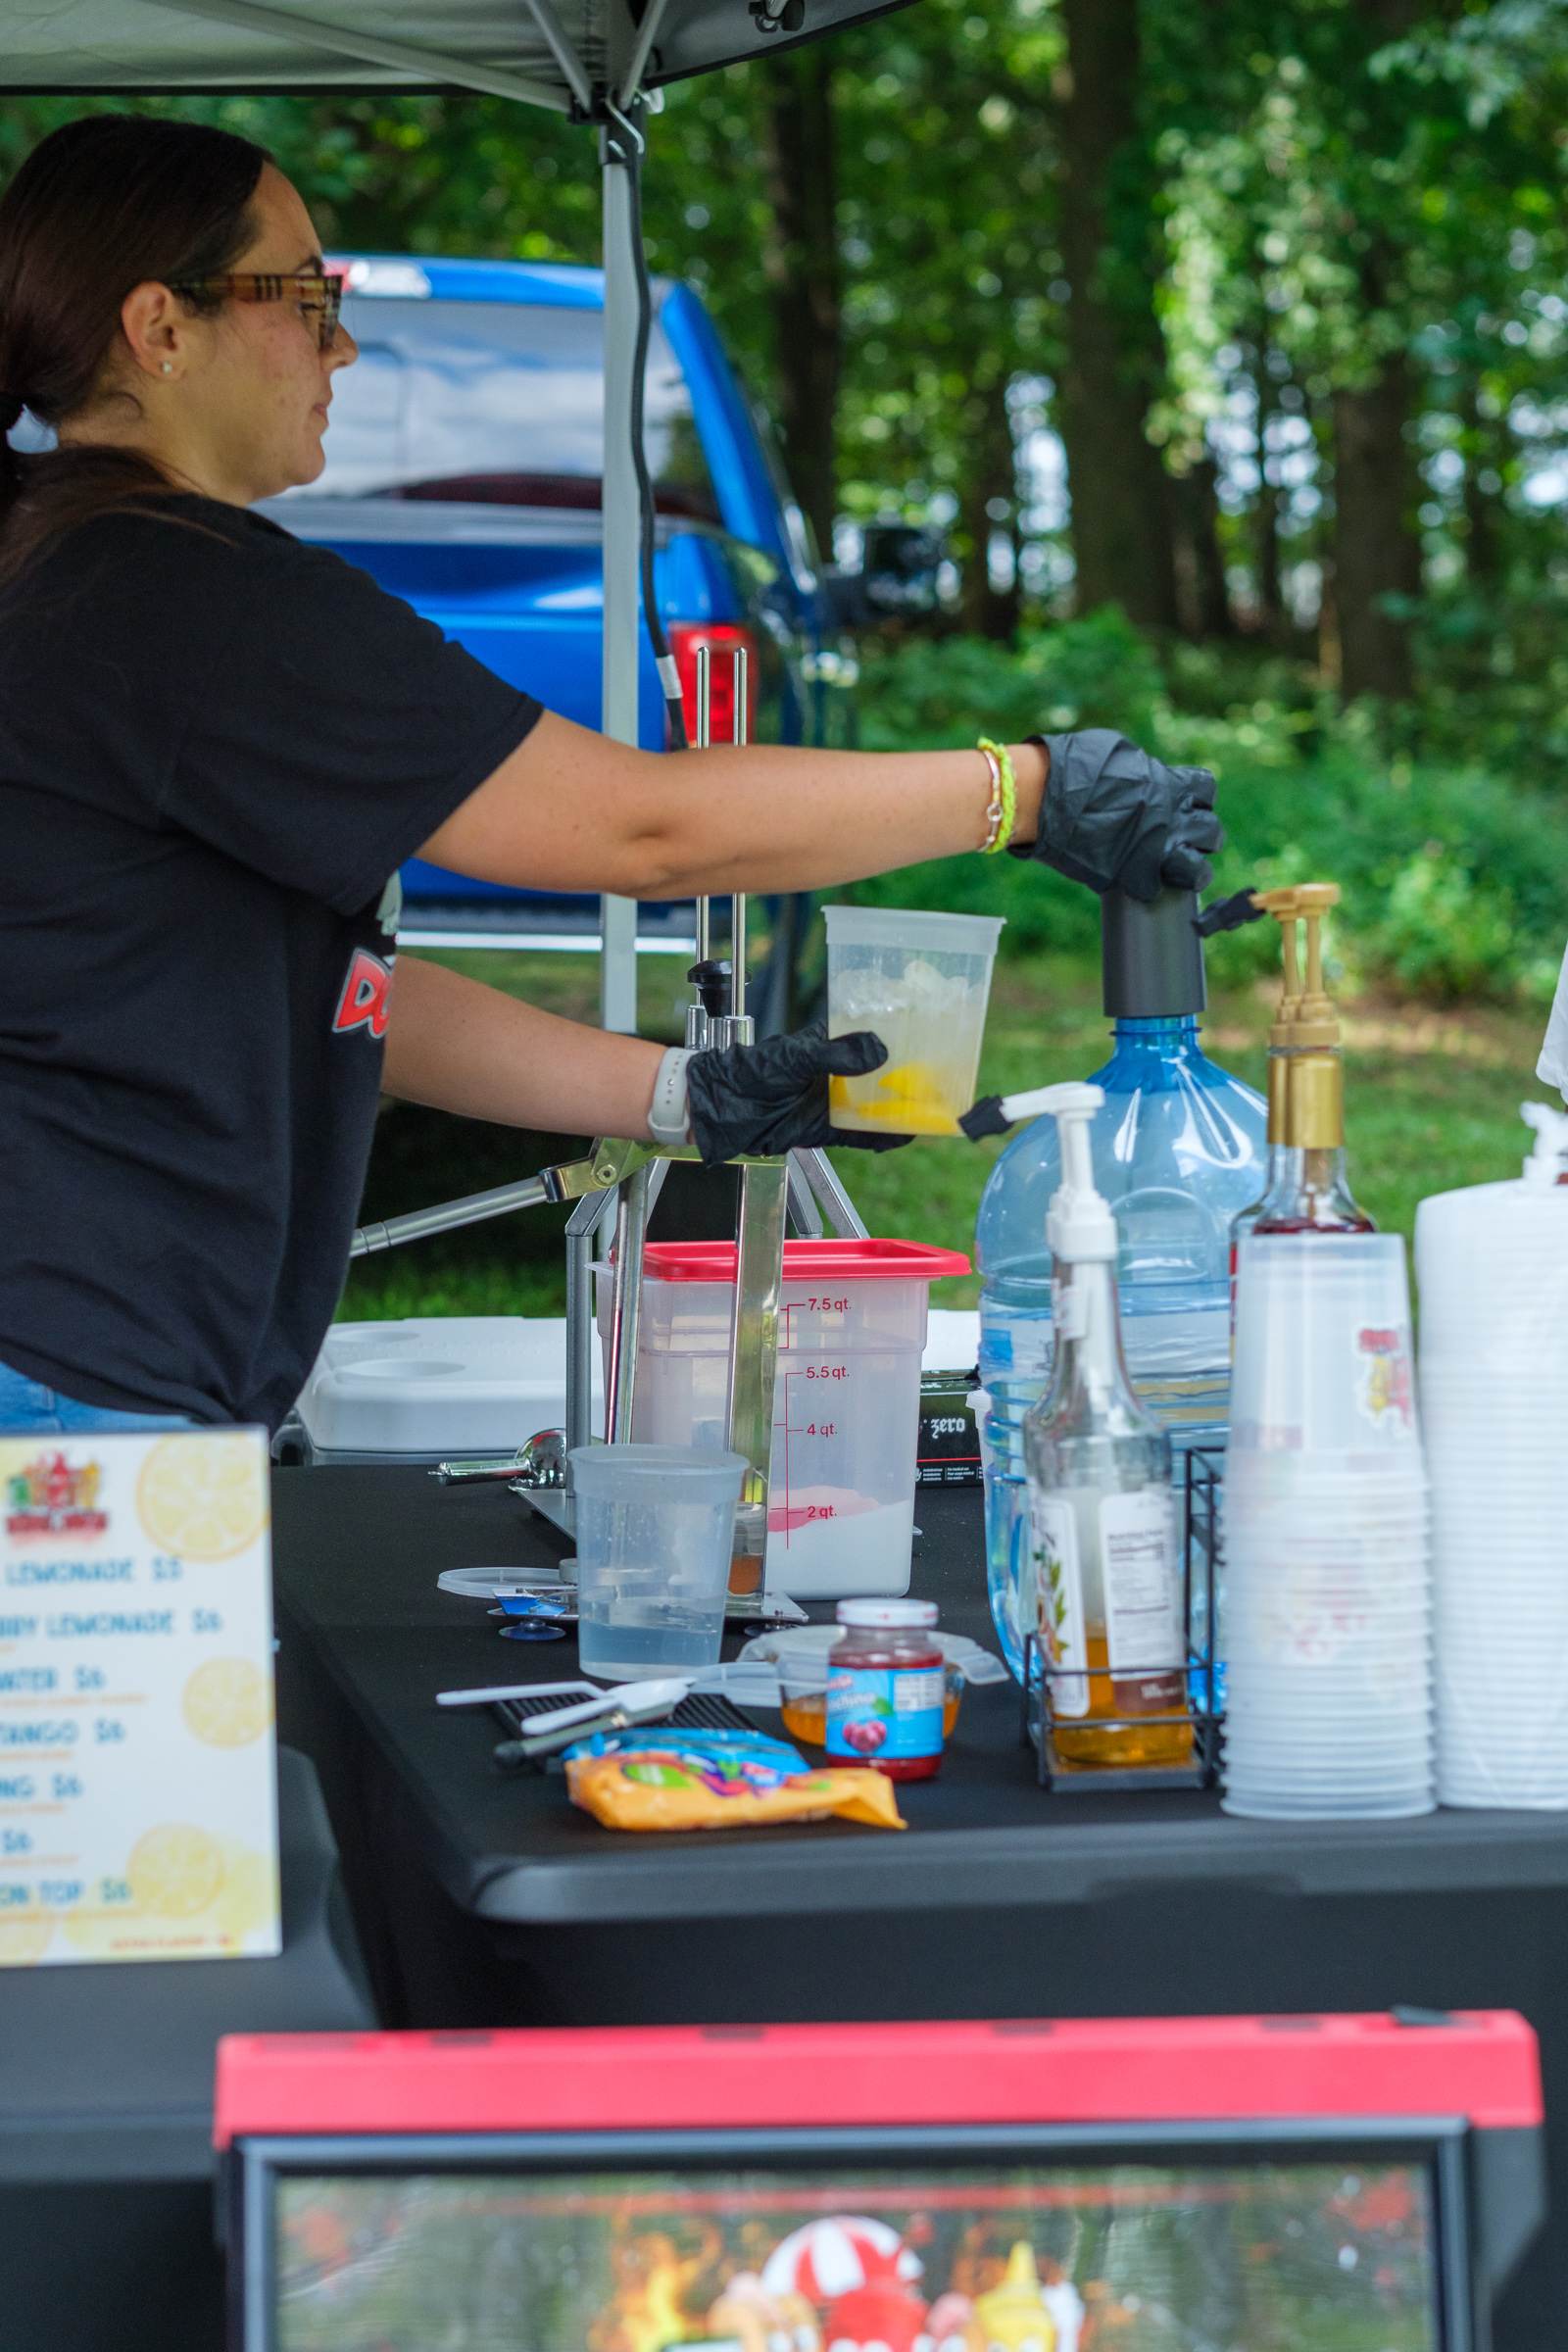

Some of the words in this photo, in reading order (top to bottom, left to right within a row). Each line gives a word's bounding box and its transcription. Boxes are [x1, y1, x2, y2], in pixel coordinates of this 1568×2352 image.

[808, 1298, 831, 1311] 7.5
[834, 1298, 852, 1313] qt.
[806, 1366, 830, 1379] 5.5
[832, 1365, 850, 1381] qt.
[807, 1423, 816, 1436] 4
[819, 1422, 838, 1439] qt.
[930, 1417, 966, 1440] zero
[807, 1505, 816, 1518] 2
[818, 1504, 837, 1519] qt.
[7, 1558, 133, 1584] LEMONADE
[46, 1611, 172, 1638] LEMONADE
[39, 1880, 82, 1904] TOP
